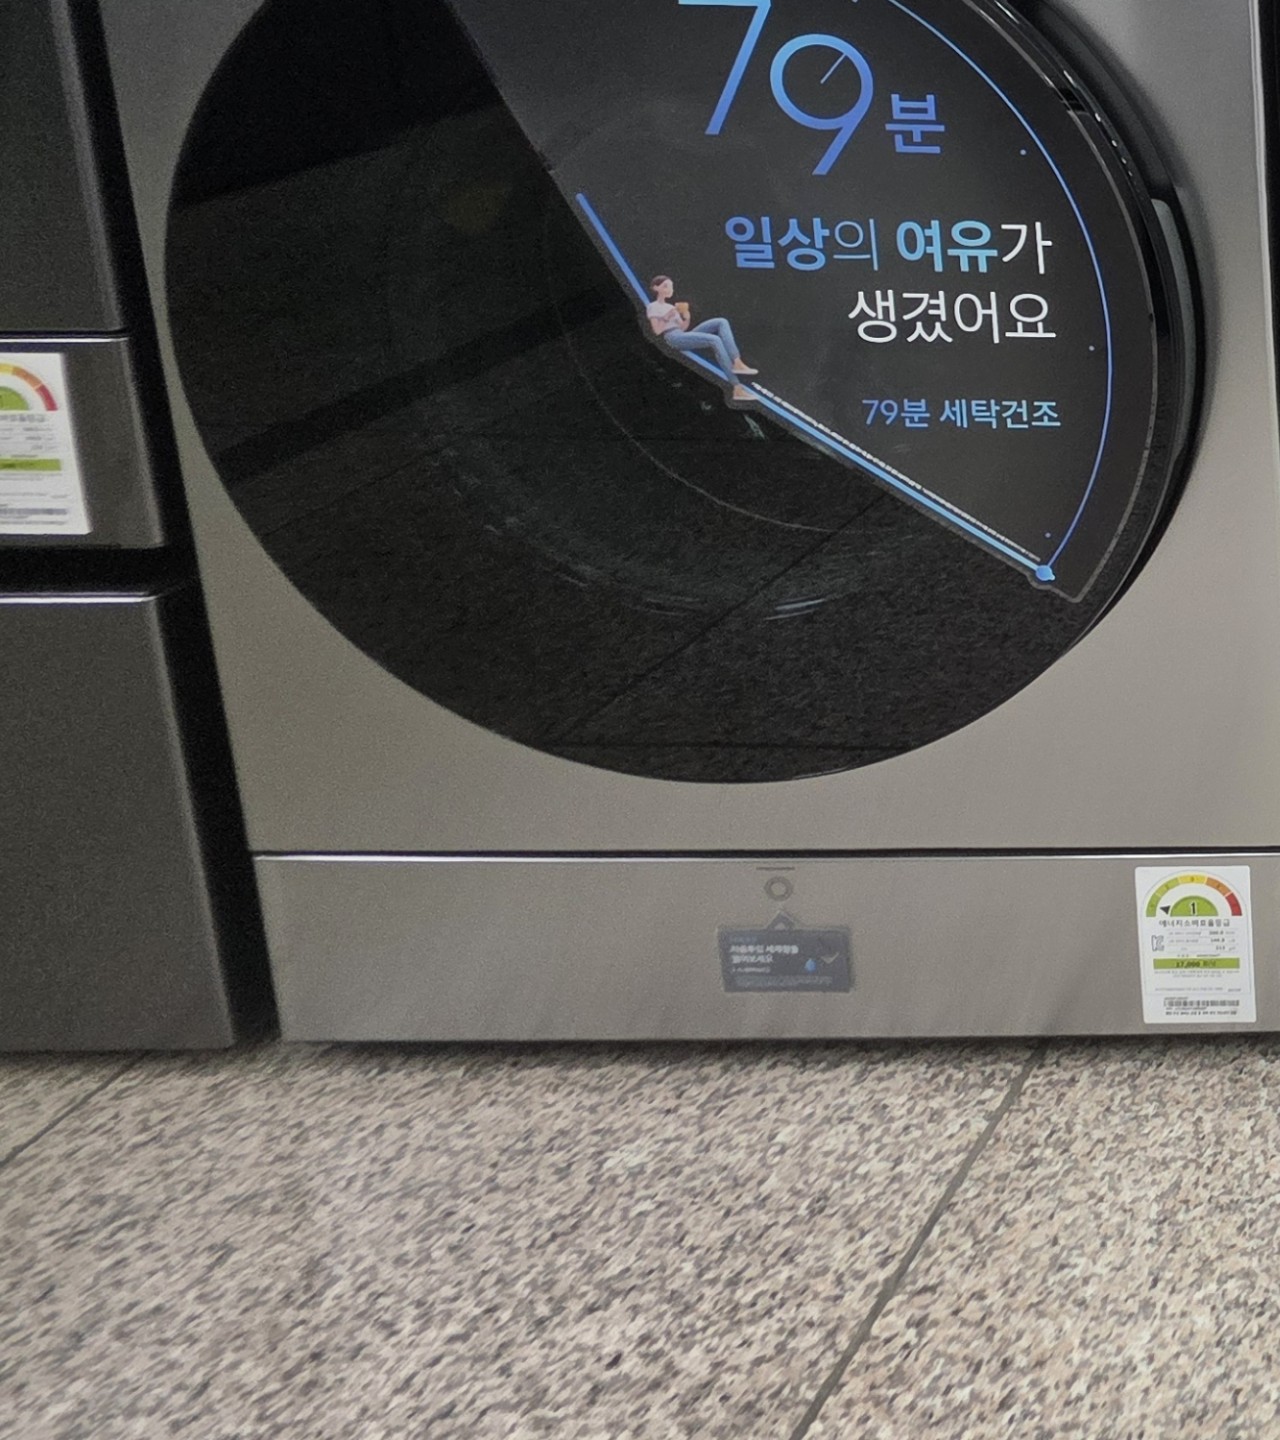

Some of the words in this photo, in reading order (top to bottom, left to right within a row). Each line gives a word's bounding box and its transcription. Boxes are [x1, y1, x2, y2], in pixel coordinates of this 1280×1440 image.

[725, 215, 879, 272] 일상의
[896, 219, 1053, 274] 여유가
[848, 289, 1056, 344] 생겼어요
[862, 398, 930, 428] 79분
[940, 399, 1061, 428] 세탁건조
